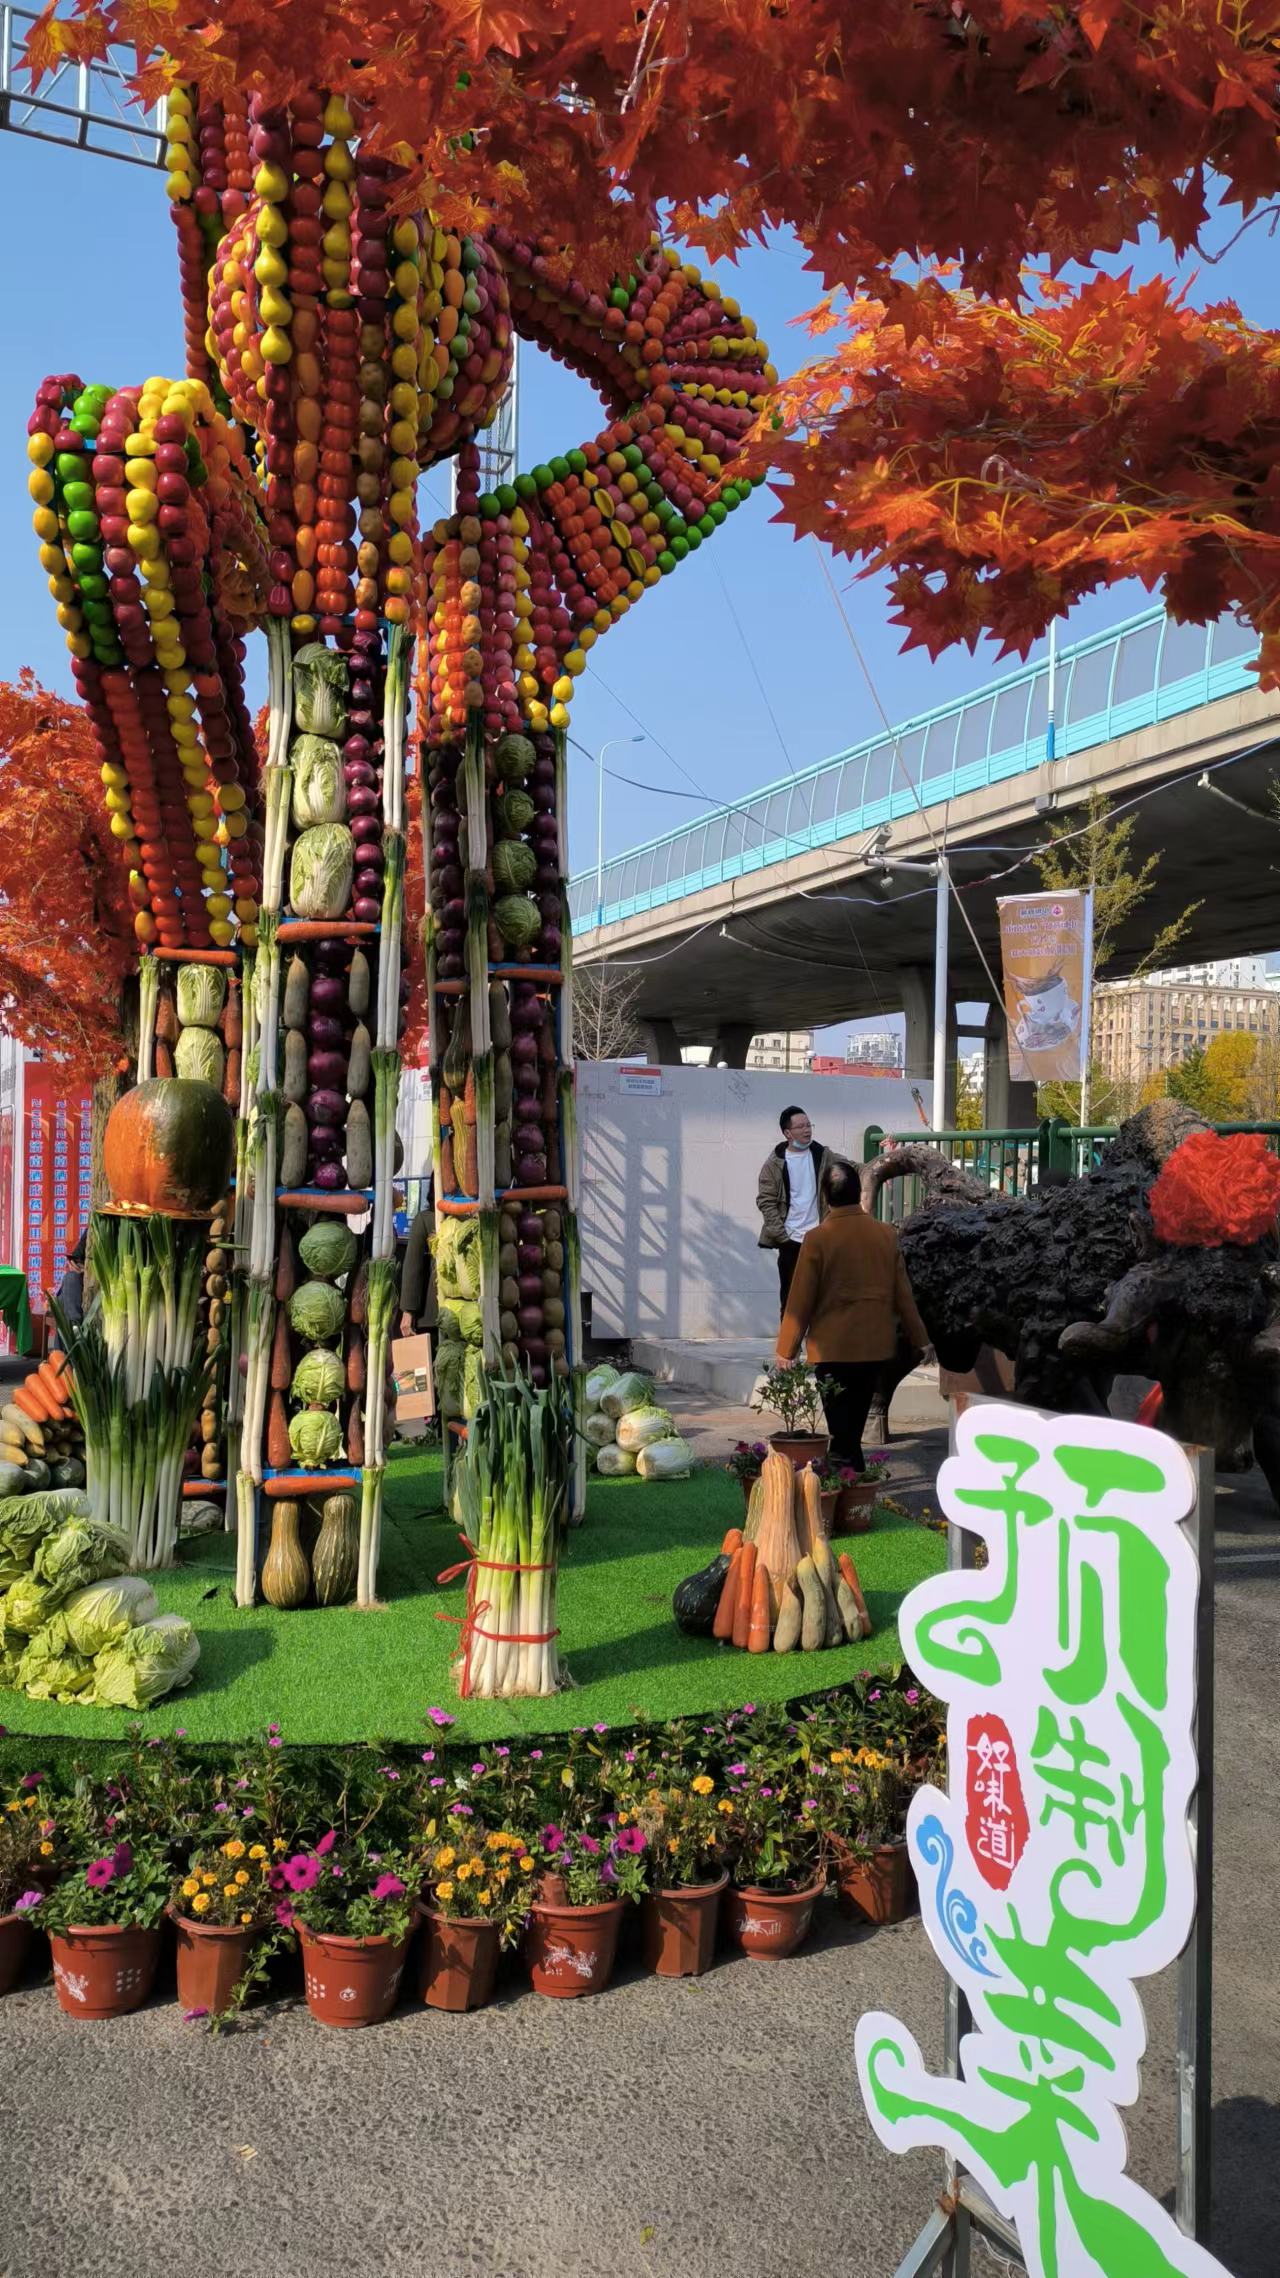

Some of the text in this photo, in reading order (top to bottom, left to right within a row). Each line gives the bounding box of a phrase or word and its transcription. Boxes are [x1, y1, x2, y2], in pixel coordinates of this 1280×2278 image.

[867, 1433, 1190, 2278] 预制菜
[967, 1733, 1015, 1869] 好味道
